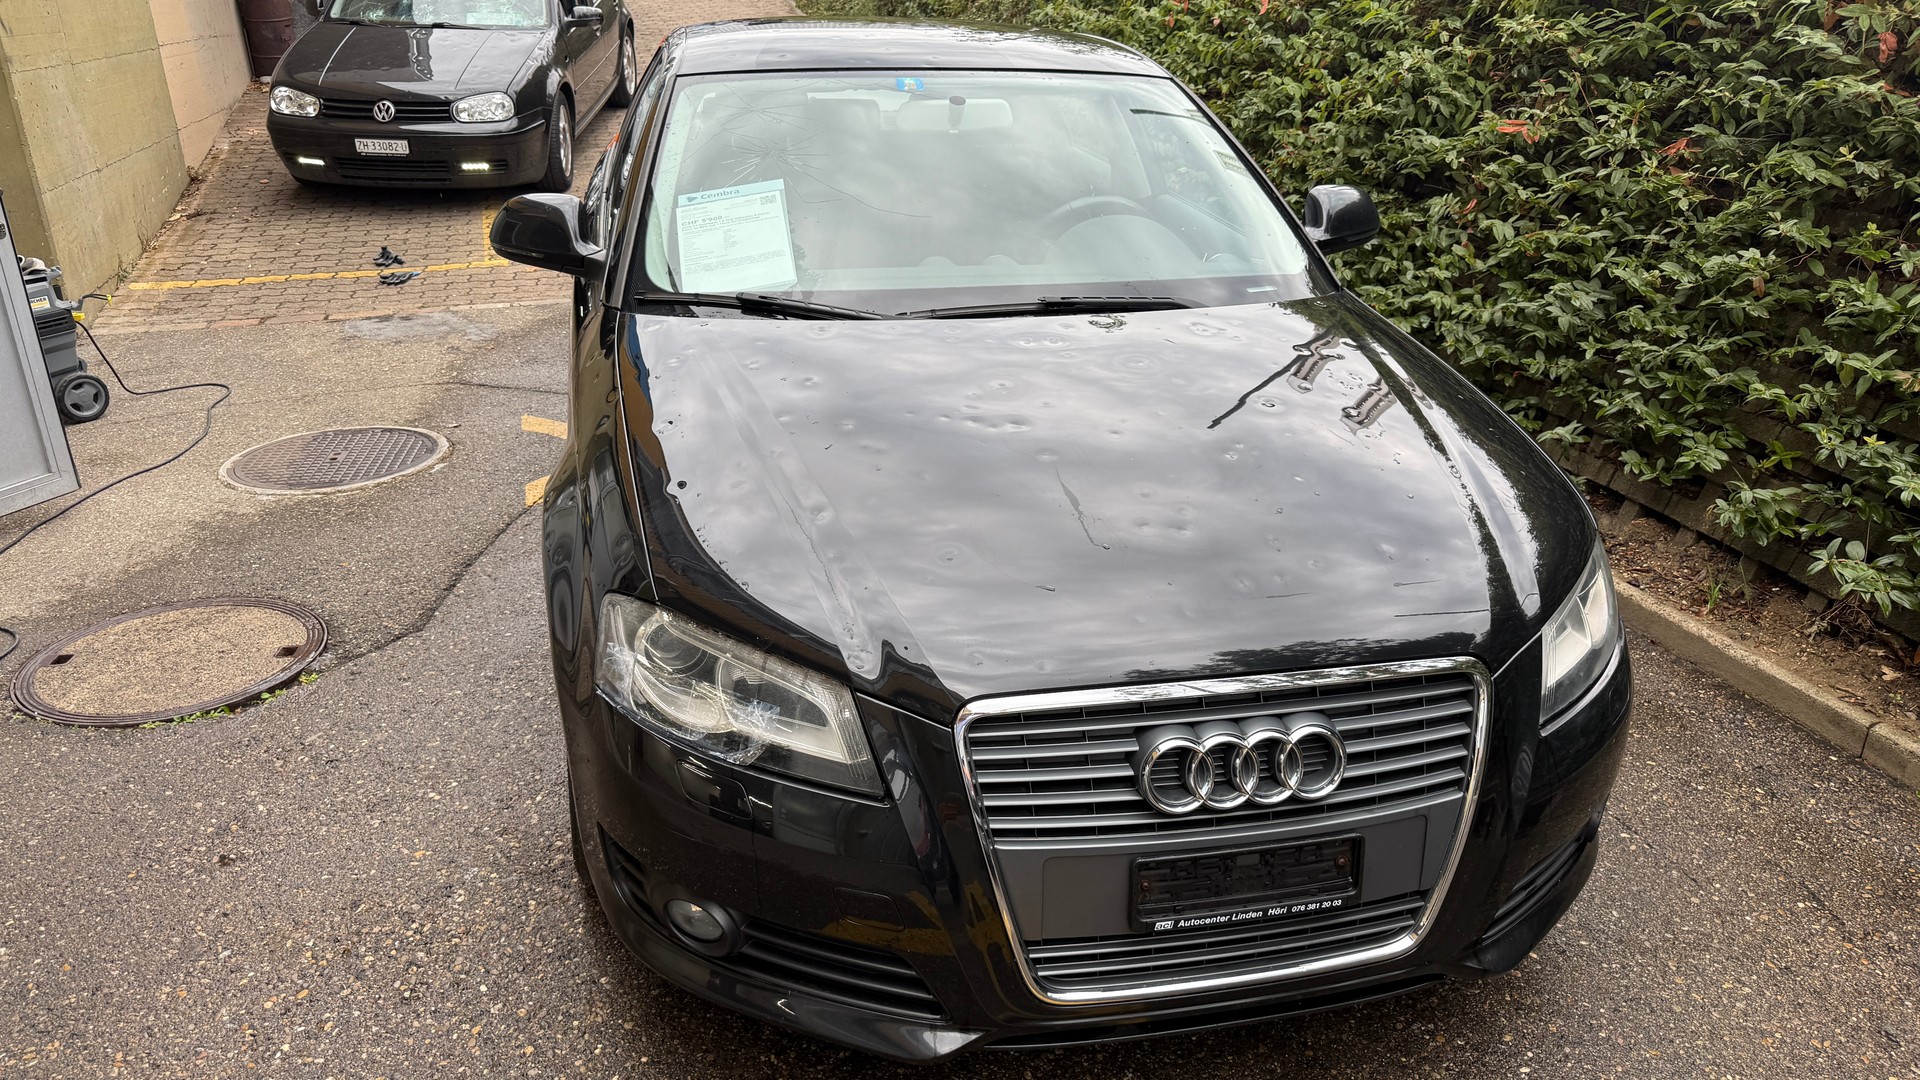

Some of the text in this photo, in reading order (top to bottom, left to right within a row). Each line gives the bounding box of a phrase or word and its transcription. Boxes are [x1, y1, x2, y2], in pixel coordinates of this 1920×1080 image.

[700, 188, 740, 200] Cembra
[681, 219, 699, 227] CHF
[1177, 914, 1230, 928] Autocenter
[1231, 910, 1263, 921] Linden
[1267, 906, 1287, 916] Höri
[1291, 904, 1306, 913] 076
[1306, 903, 1320, 911] 381
[1321, 901, 1332, 909] 20
[1332, 899, 1342, 907] 03
